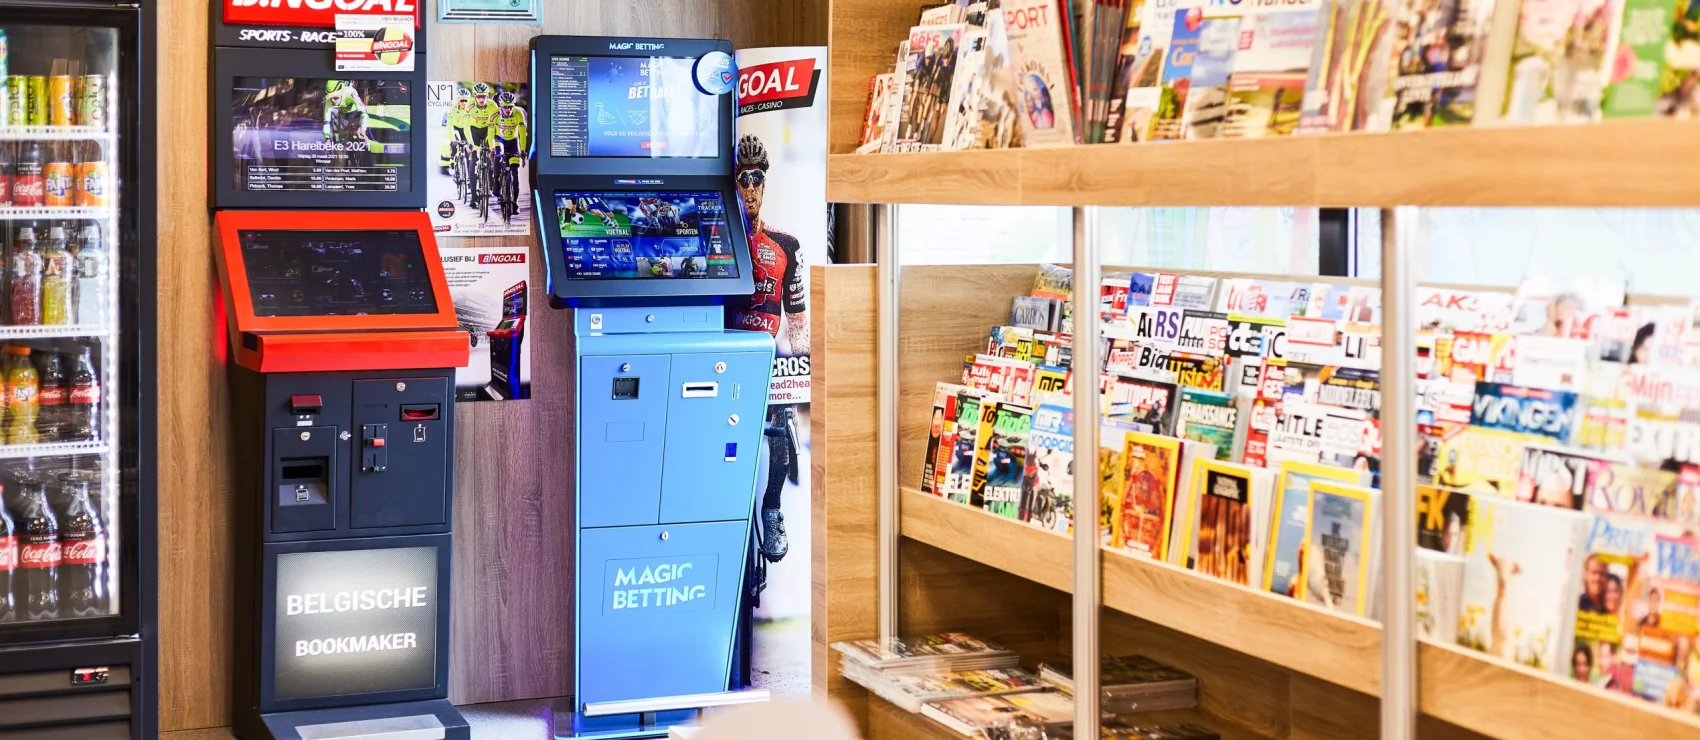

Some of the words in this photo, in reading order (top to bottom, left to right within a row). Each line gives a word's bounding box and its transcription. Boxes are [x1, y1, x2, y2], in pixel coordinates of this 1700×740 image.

[239, 29, 291, 41] SPORTS
[738, 66, 800, 99] GOAL
[757, 101, 783, 111] CASINO
[274, 141, 289, 151] E3
[292, 140, 344, 151] Harelbeke
[346, 141, 371, 152] 2021
[605, 228, 630, 236] VOETBAL
[614, 562, 693, 587] MAGIC
[286, 586, 427, 616] BELGISCHE
[612, 584, 706, 610] BETTING
[295, 632, 417, 657] BOOKMAKER
